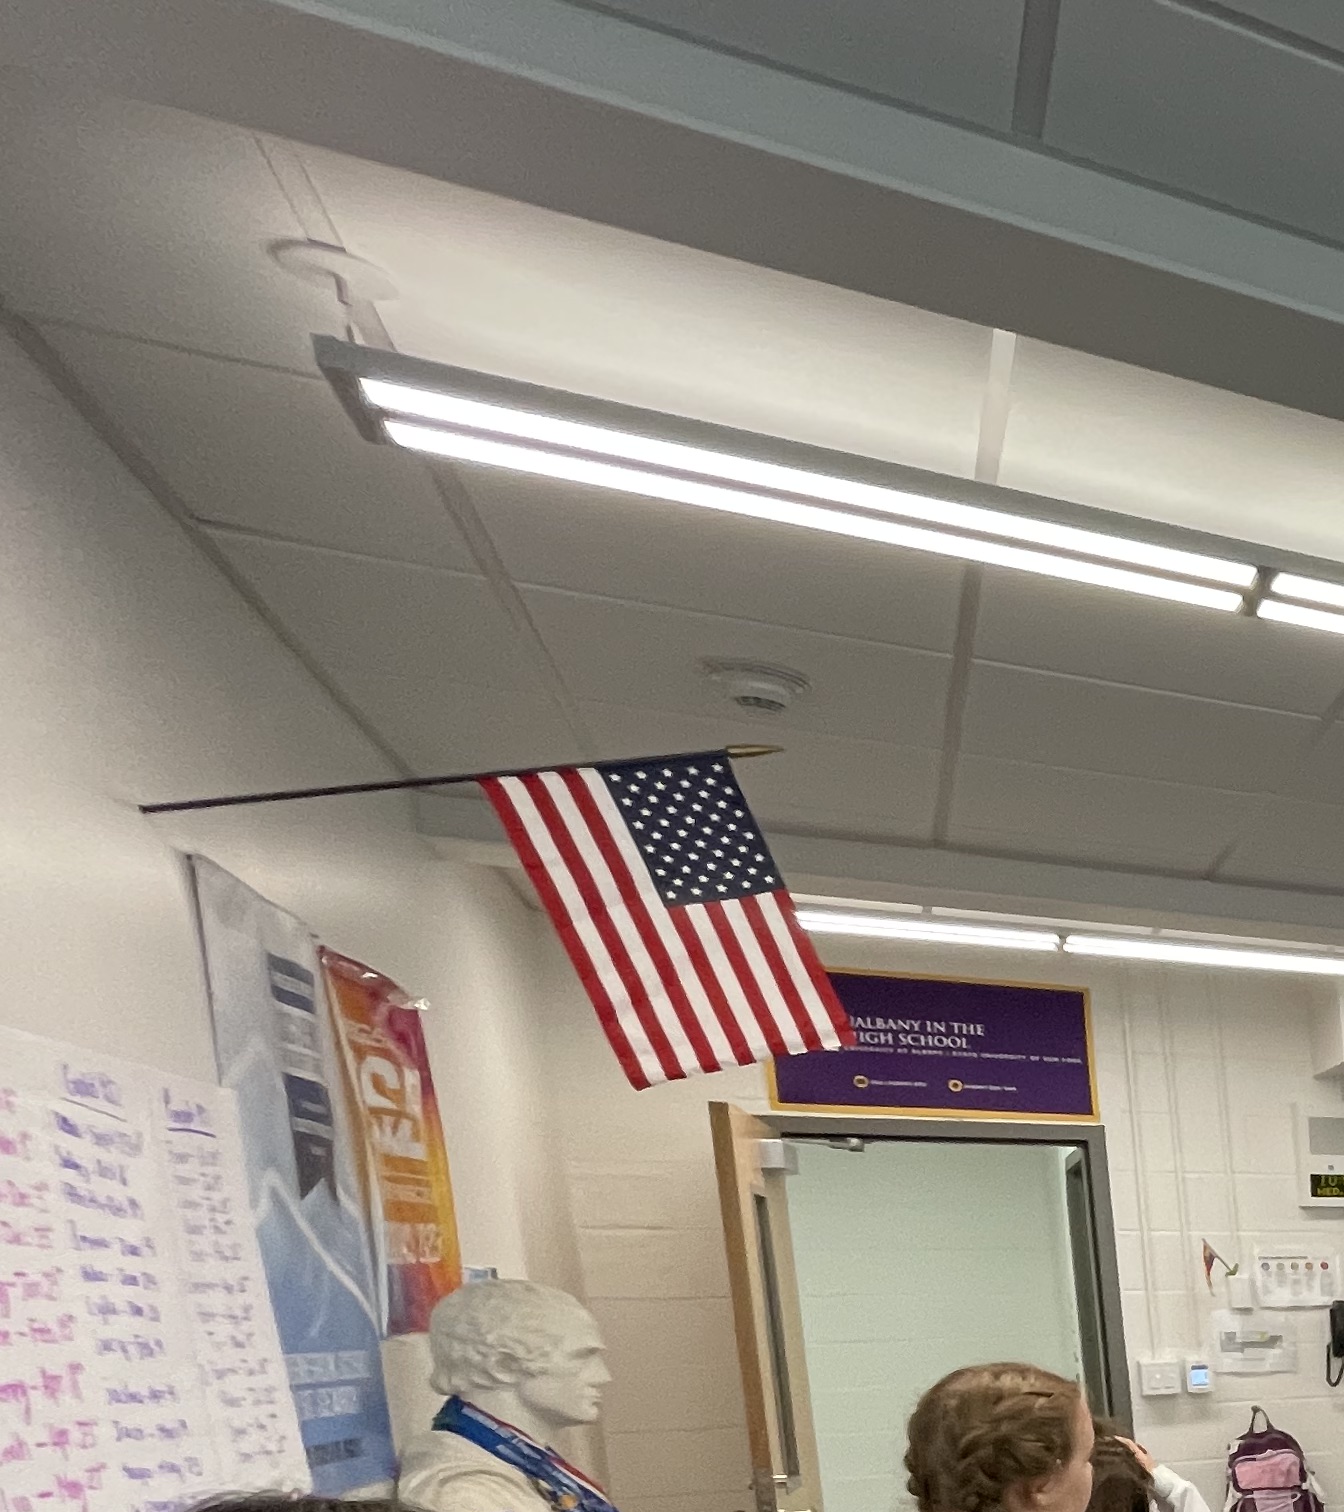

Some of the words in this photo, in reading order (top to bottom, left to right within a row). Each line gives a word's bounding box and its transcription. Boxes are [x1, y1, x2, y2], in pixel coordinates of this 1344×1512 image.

[926, 1020, 946, 1033] IN
[949, 1021, 985, 1036] THE
[898, 1033, 968, 1049] SCHOOL
